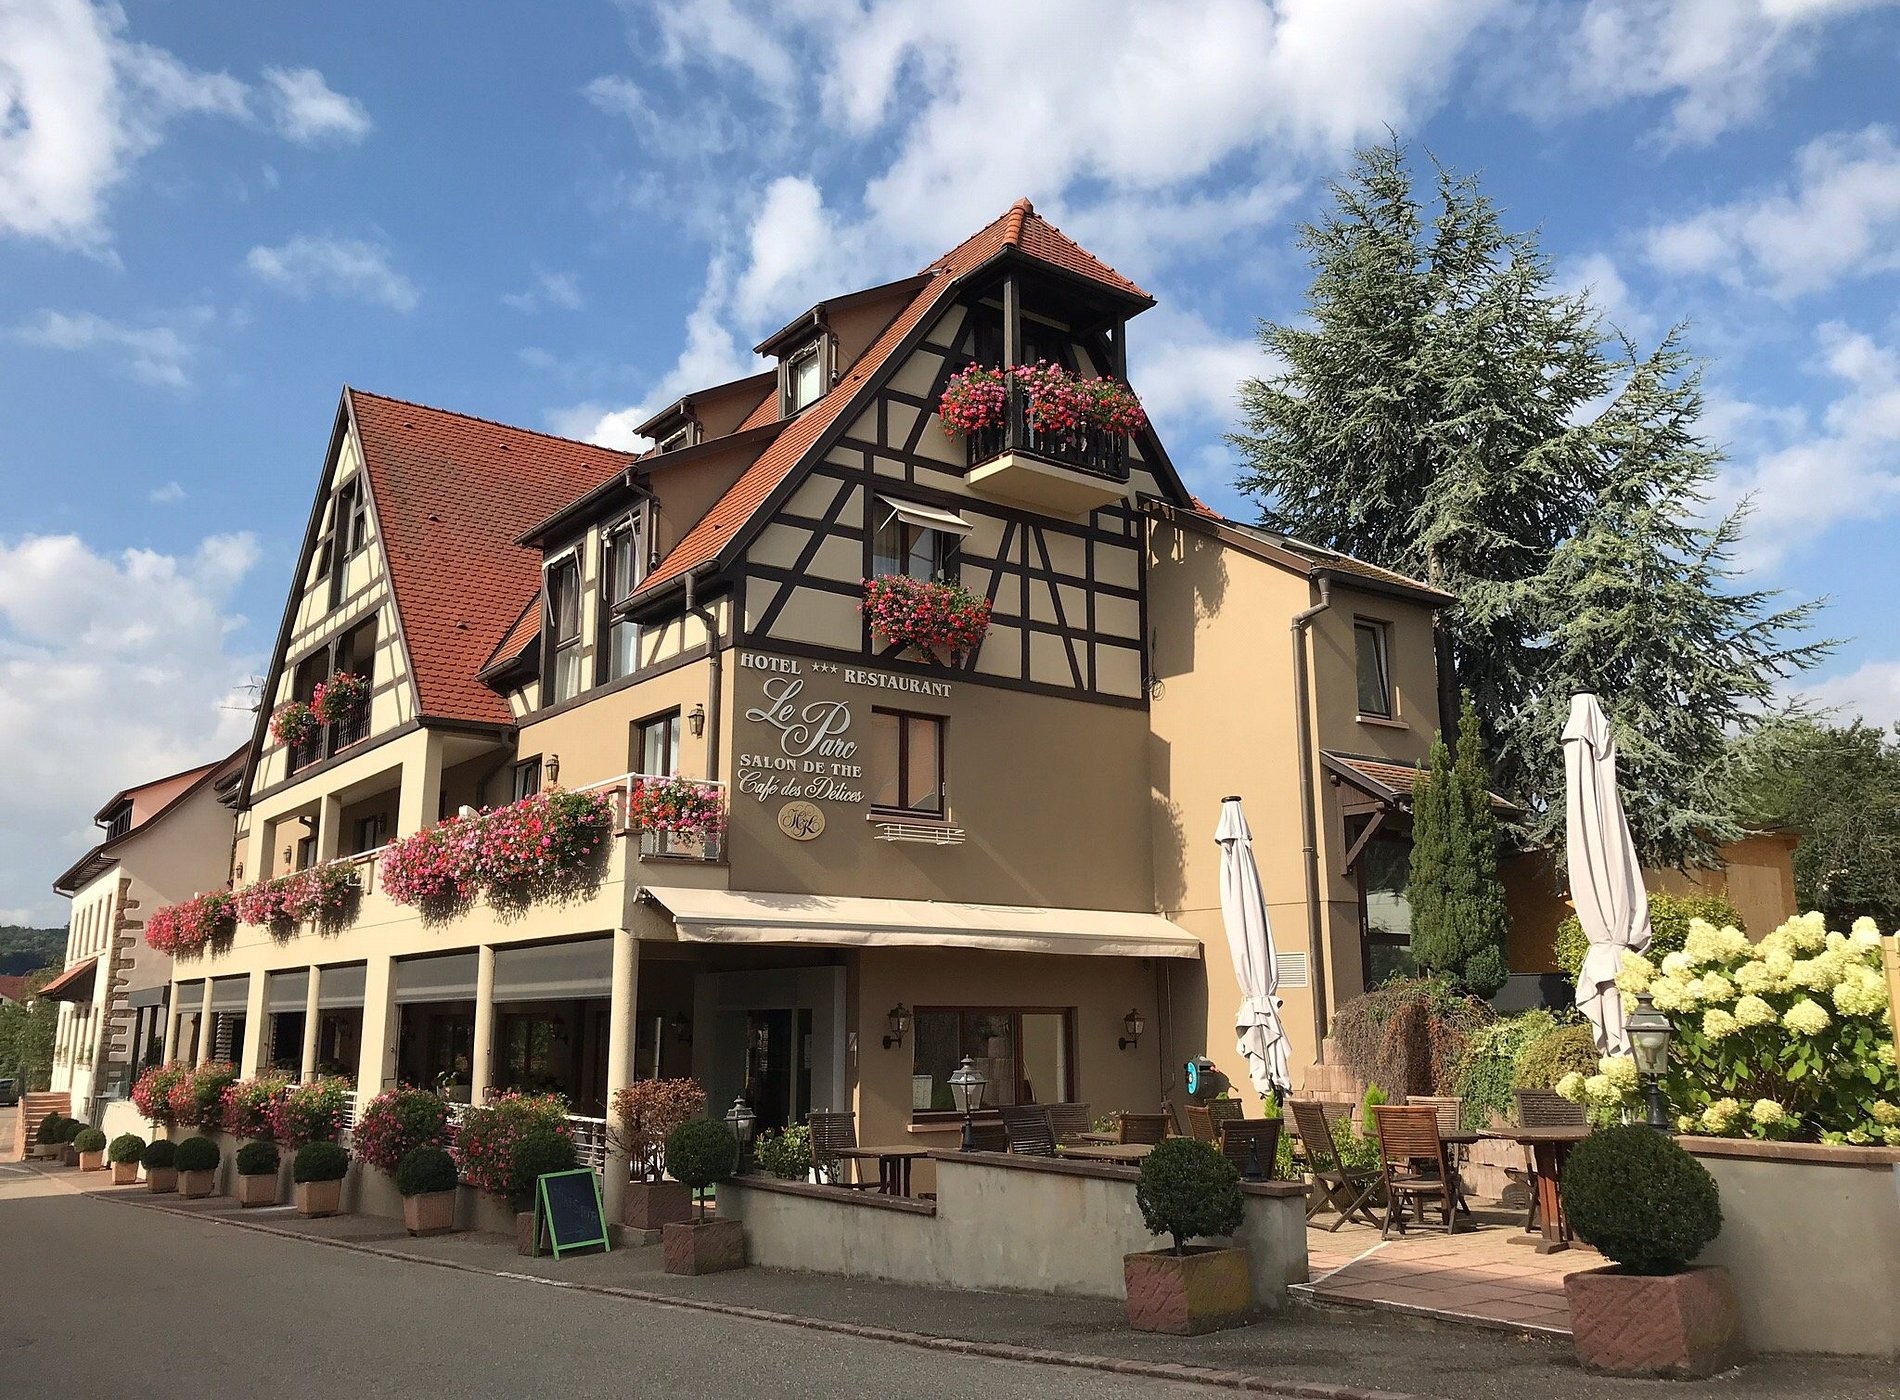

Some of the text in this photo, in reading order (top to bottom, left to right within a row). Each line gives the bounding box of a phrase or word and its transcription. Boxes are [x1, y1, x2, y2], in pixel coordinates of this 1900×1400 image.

[740, 652, 952, 698] HOTEL RESTAURANT
[745, 677, 804, 730] Le
[780, 701, 858, 760] Parc
[737, 769, 865, 804] Café des Délices
[739, 754, 863, 778] SALON DE THE
